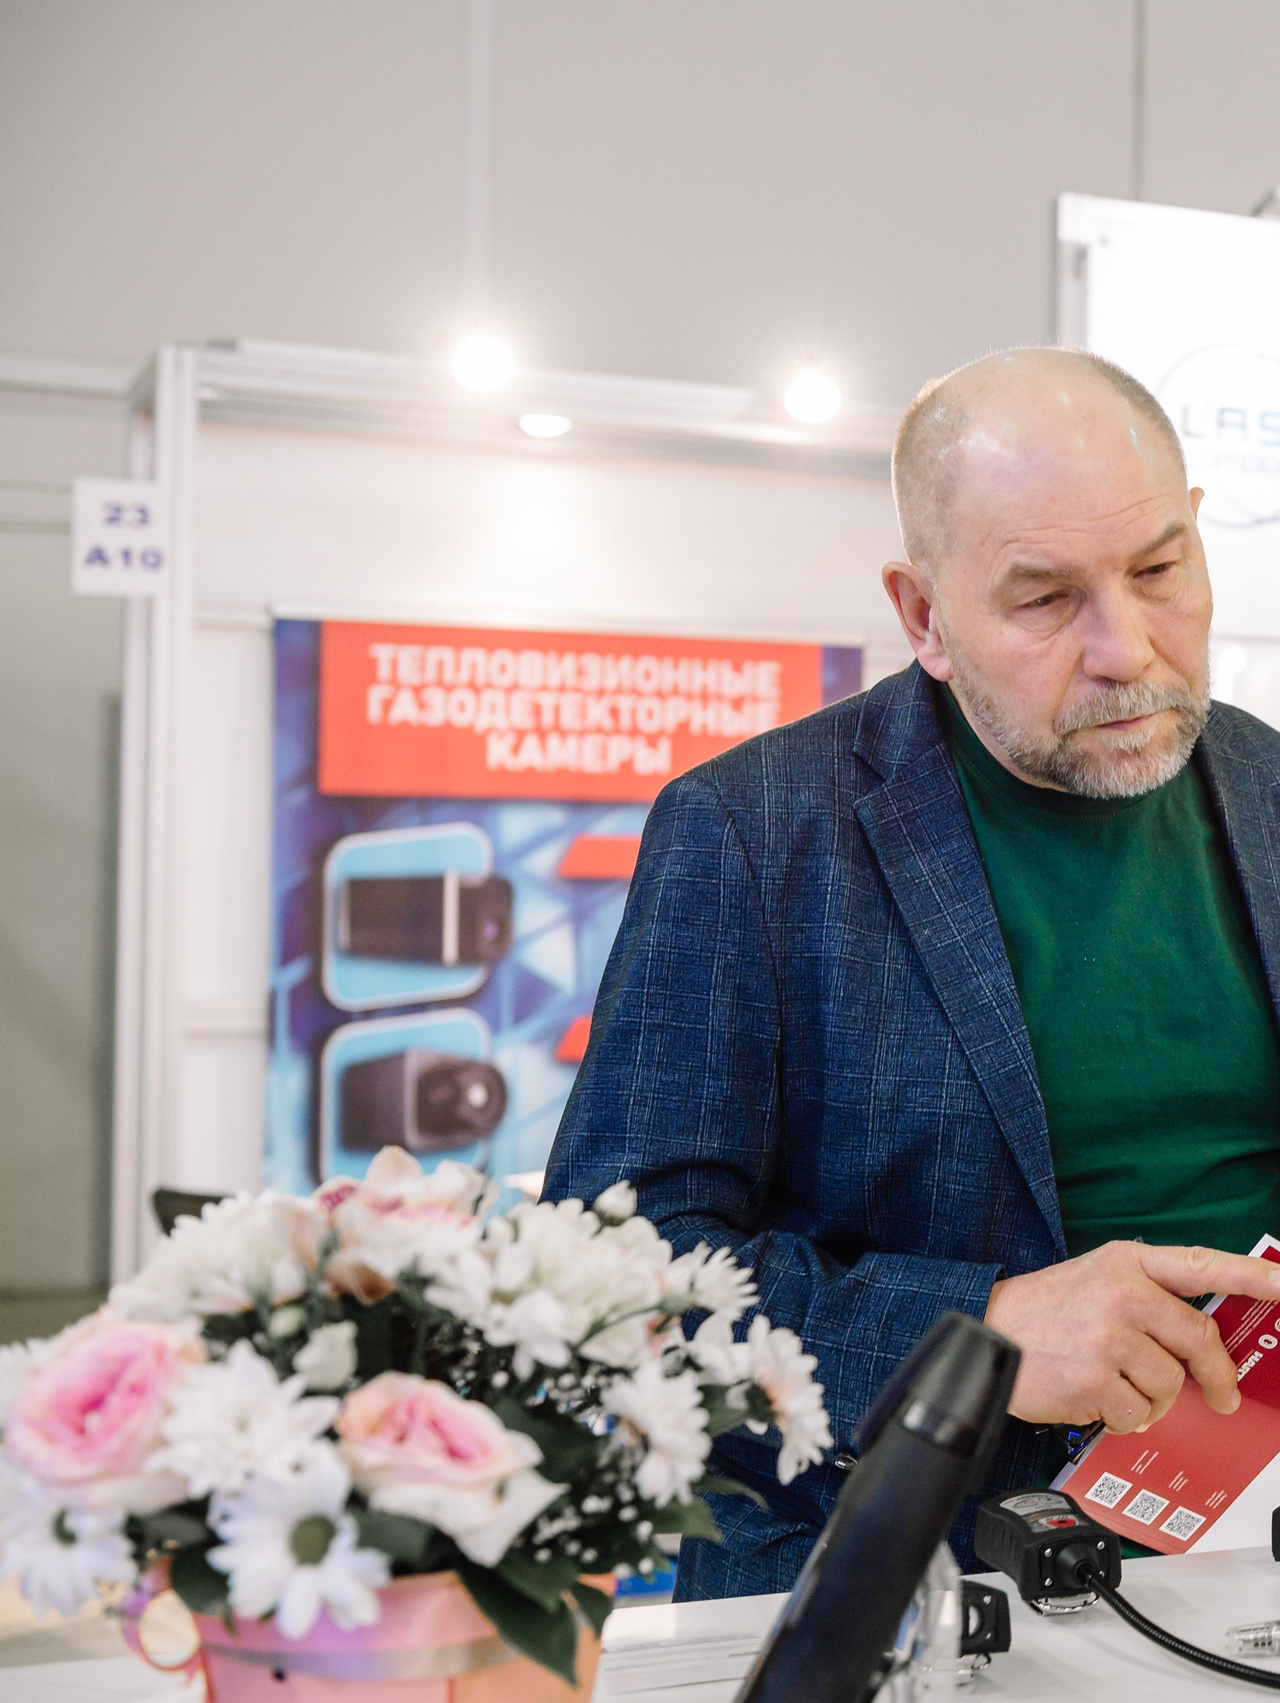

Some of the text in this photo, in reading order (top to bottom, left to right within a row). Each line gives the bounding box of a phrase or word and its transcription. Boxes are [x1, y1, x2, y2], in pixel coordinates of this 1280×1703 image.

[102, 501, 150, 529] 23
[84, 544, 163, 573] A10
[368, 643, 783, 699] ТЕПЛОВИЗИОННЫЕ
[366, 684, 782, 737] ГАЗОДЕТЕКТОРНЫЕ
[486, 729, 672, 774] КАМЕРЫ
